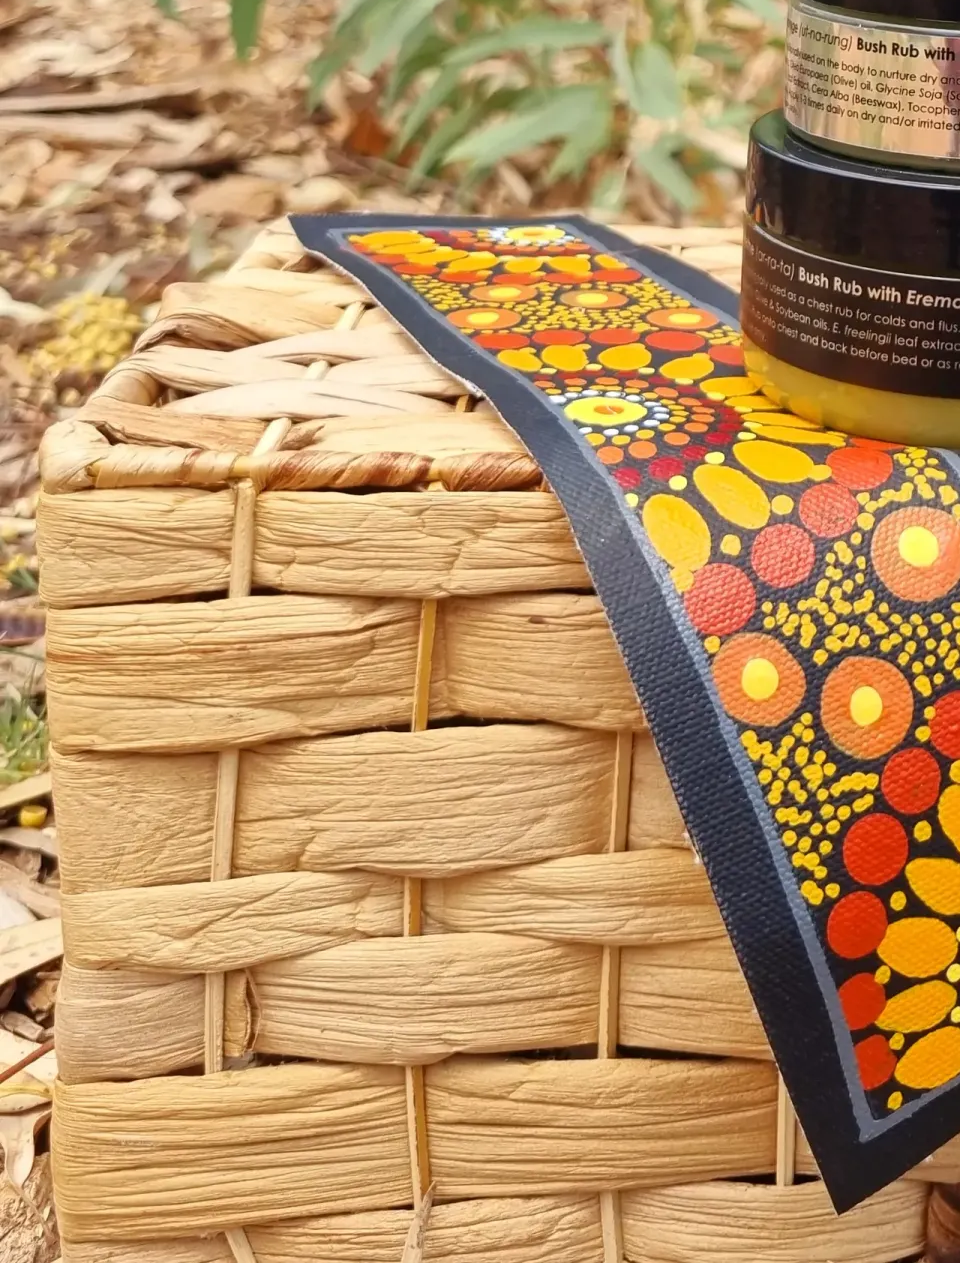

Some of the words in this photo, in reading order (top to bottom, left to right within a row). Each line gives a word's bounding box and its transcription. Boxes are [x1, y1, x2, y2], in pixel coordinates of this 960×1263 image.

[856, 37, 887, 55] Bush
[891, 42, 920, 59] Rub
[923, 46, 956, 62] with
[816, 58, 826, 67] on
[827, 57, 840, 70] the
[841, 61, 865, 76] body
[867, 66, 878, 78] to
[879, 69, 917, 82] nurture
[919, 71, 938, 87] dry
[830, 73, 858, 91] (Olive)
[875, 82, 916, 98] Glycine
[918, 88, 943, 101] Soja
[811, 83, 829, 97] Cera
[830, 88, 849, 102] Alba
[807, 97, 825, 111] times
[826, 100, 846, 118] daily
[847, 108, 859, 119] on
[860, 111, 877, 124] dry
[878, 115, 915, 128] and/or
[917, 118, 960, 132] irritated
[755, 245, 795, 281] (ar-ra-ta)
[798, 266, 829, 289] Bush
[833, 276, 863, 296] Rub
[867, 286, 901, 304] with
[775, 301, 811, 326] Soybean
[832, 321, 842, 335] E.
[844, 324, 892, 345] freelingii
[894, 333, 918, 348] leaf
[787, 290, 798, 303] as
[798, 295, 805, 305] a
[806, 298, 834, 313] chest
[835, 305, 854, 319] rub
[856, 308, 871, 322] for
[873, 312, 906, 327] colds
[909, 317, 935, 331] and
[777, 323, 799, 339] chest
[799, 332, 819, 346] and
[820, 337, 849, 354] back
[850, 344, 889, 363] before
[891, 351, 918, 367] bed
[921, 356, 934, 368] or
[936, 359, 952, 371] as
